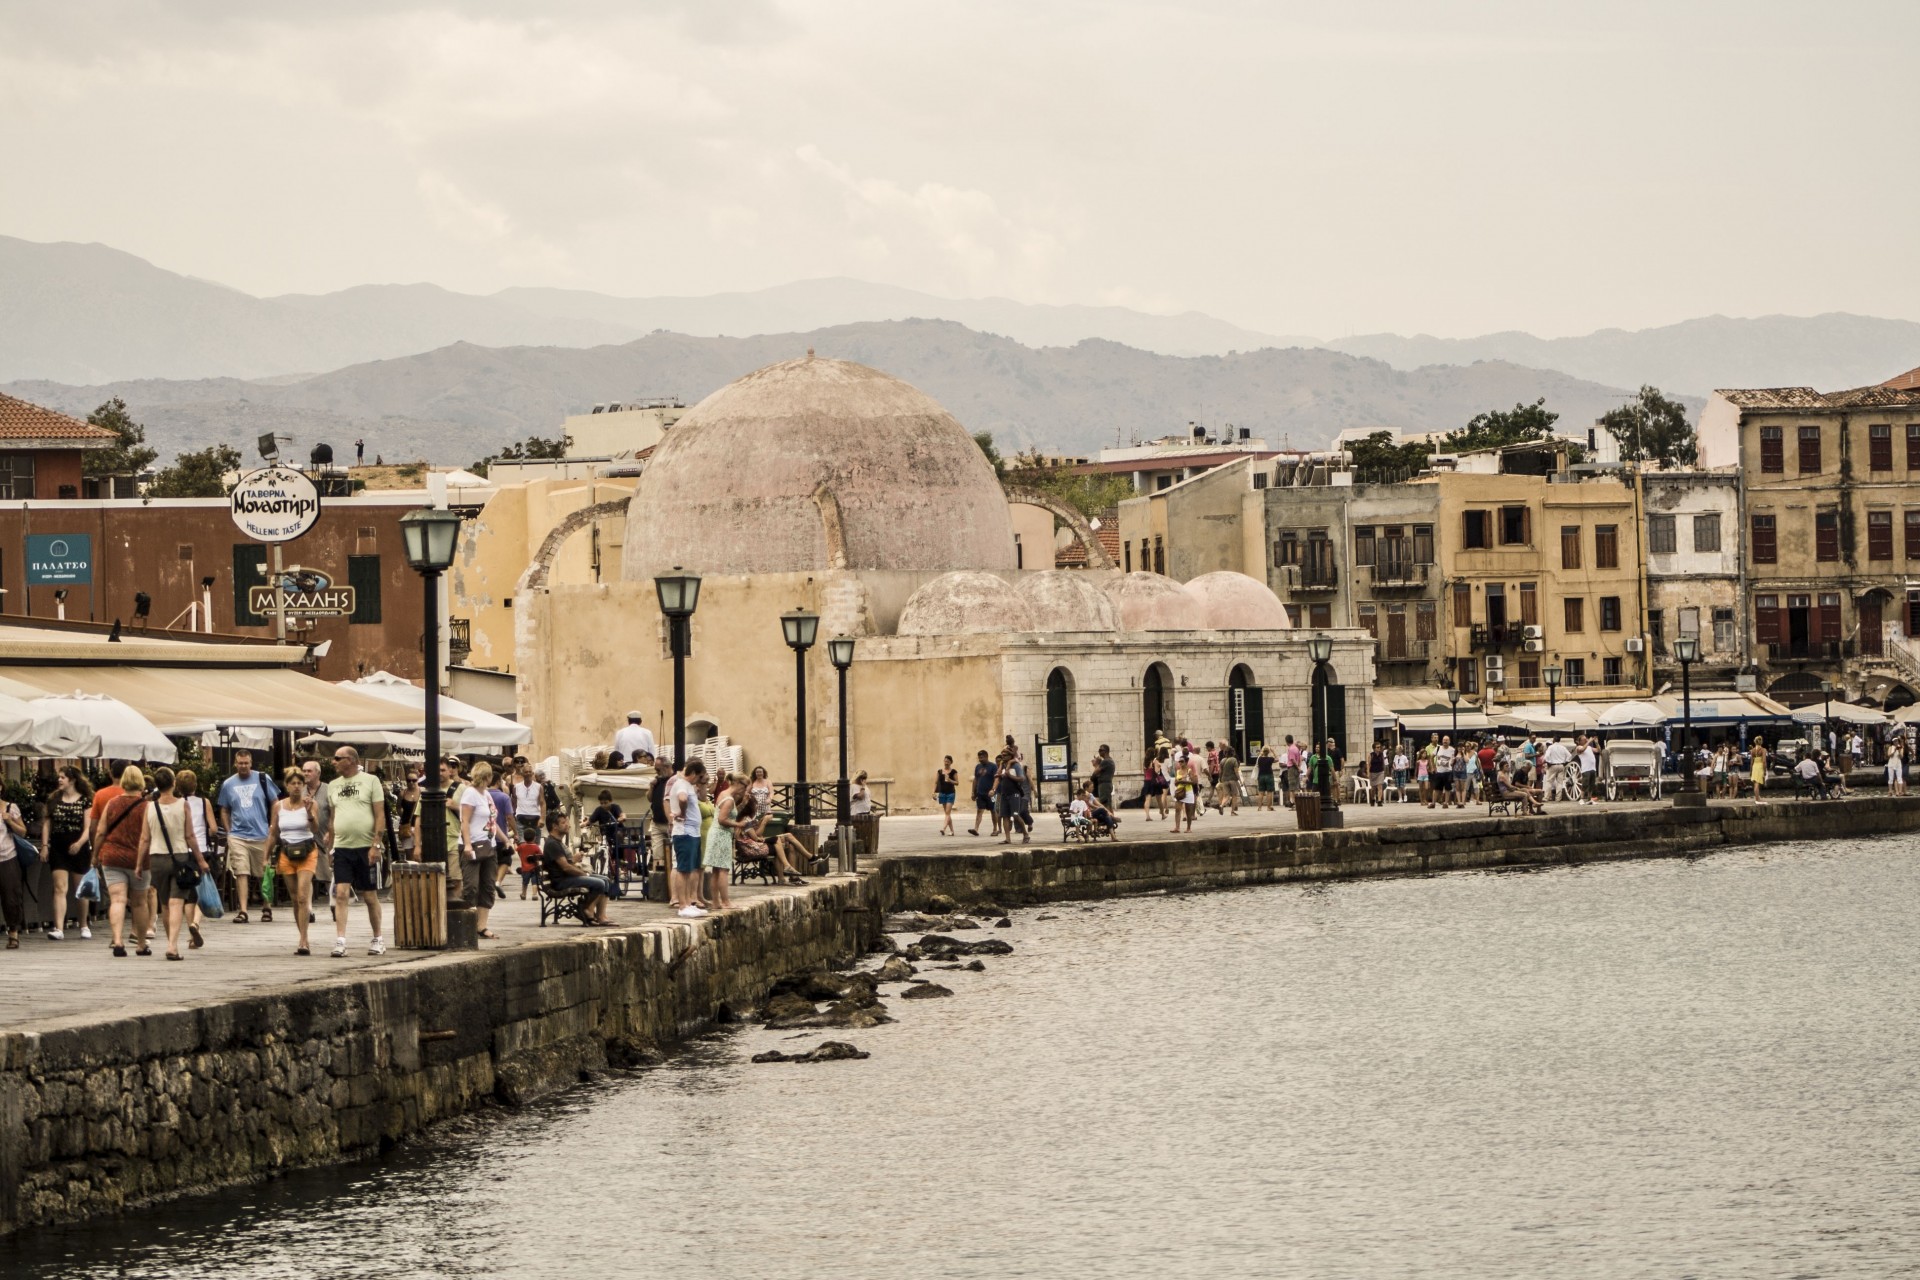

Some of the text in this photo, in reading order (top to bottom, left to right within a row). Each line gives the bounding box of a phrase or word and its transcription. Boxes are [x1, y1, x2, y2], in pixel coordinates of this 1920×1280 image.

[246, 520, 302, 536] HELLENIC TASTE
[32, 561, 87, 570] ΠΑΛΑΤΣΟ
